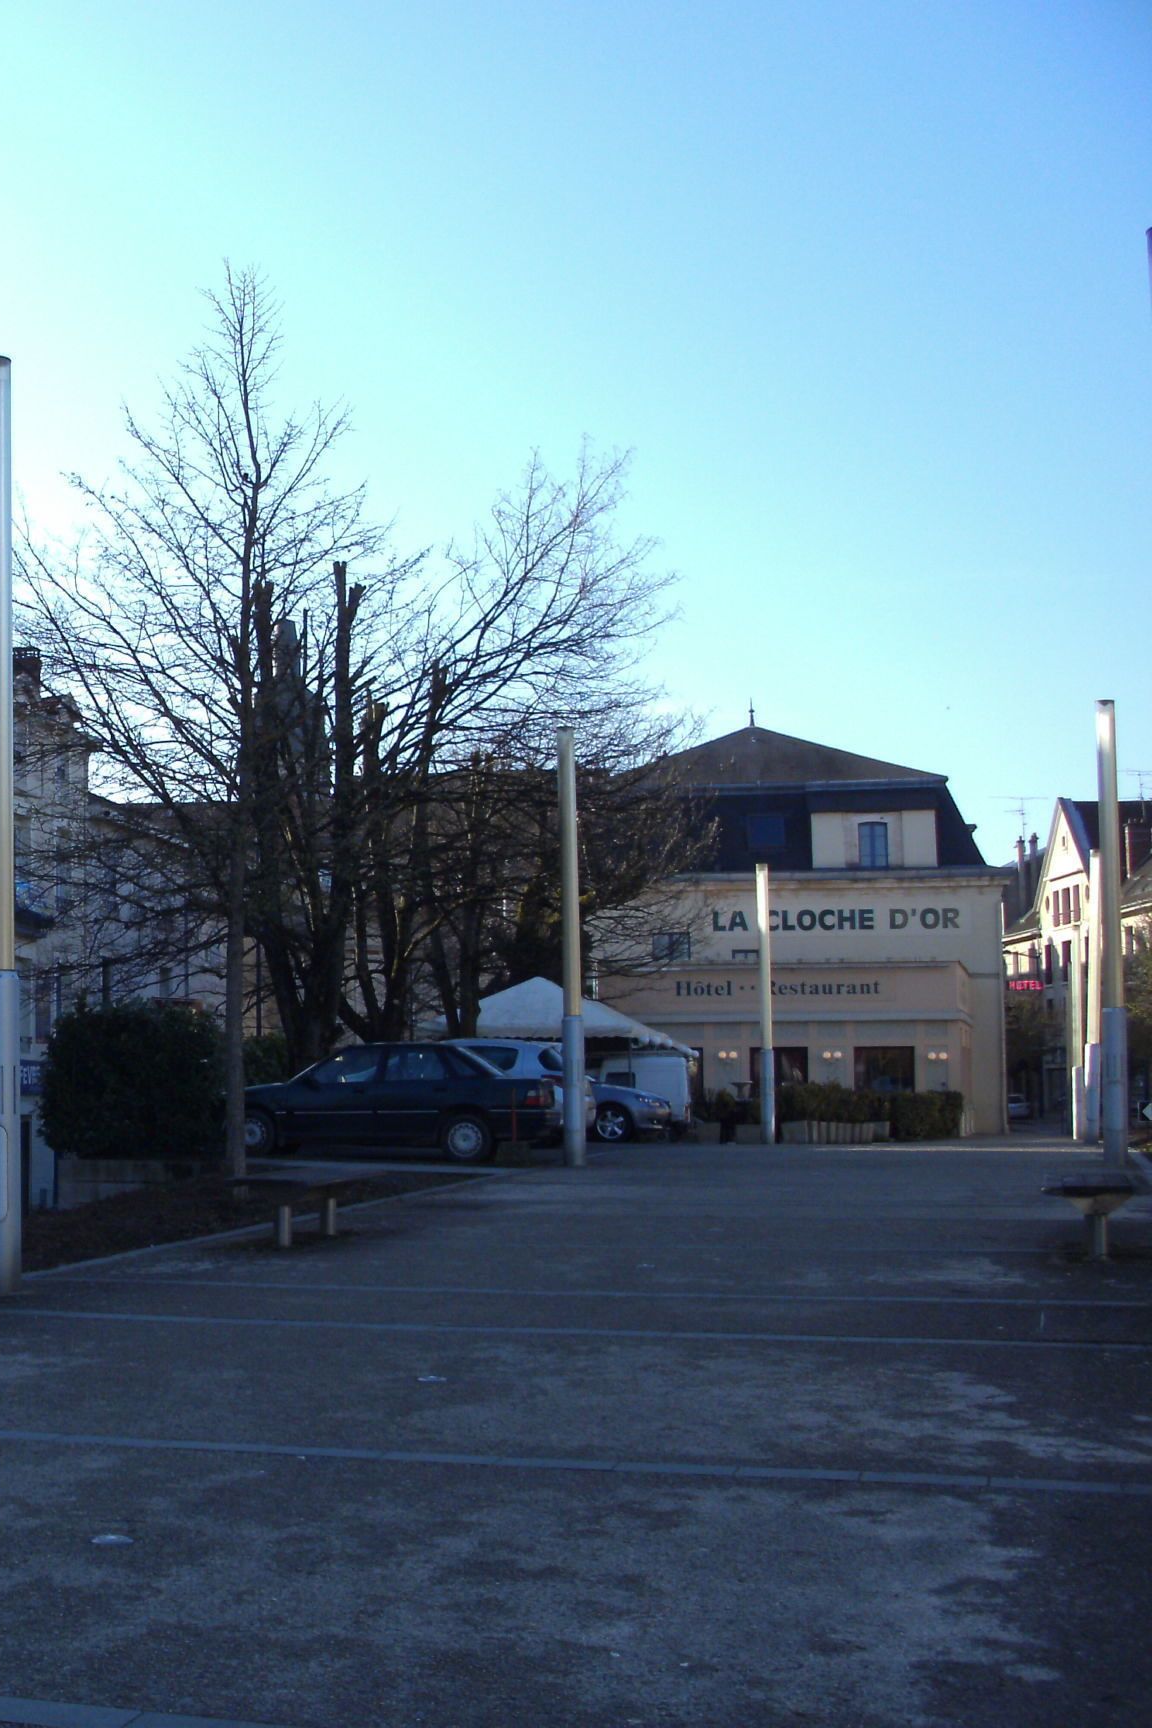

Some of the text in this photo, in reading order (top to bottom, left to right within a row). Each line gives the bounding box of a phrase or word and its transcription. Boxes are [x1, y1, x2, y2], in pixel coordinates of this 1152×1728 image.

[712, 907, 960, 932] LA CLOCHE D'OR
[675, 980, 732, 997] Hôtel
[1008, 980, 1042, 991] HOTEL
